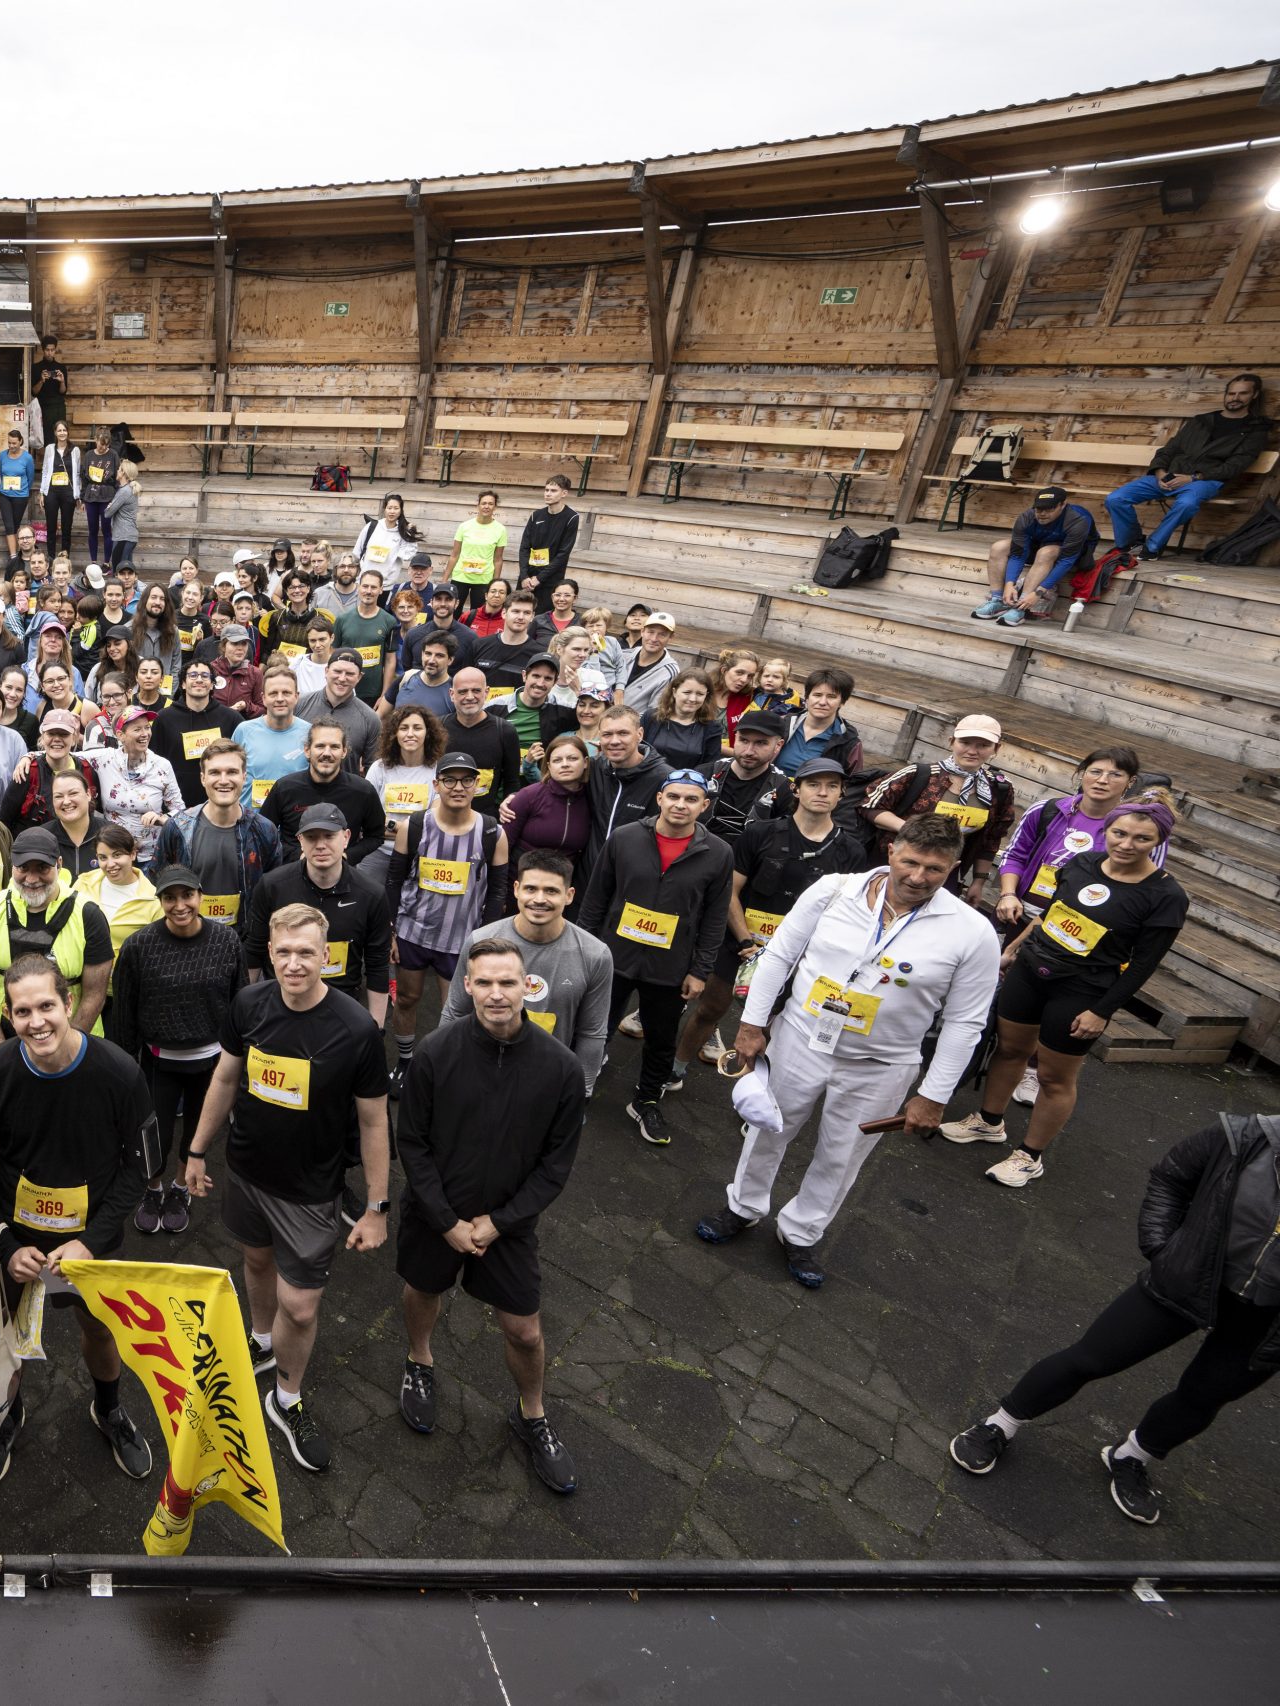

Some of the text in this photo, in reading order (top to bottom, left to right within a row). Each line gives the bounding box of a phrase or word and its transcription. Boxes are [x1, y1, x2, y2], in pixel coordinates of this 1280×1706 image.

[195, 737, 210, 748] 498
[397, 792, 415, 803] 472
[433, 869, 453, 882] 393
[208, 905, 225, 916] 185
[635, 918, 658, 934] 440
[1059, 918, 1082, 937] 460
[261, 1068, 286, 1088] 497
[35, 1199, 64, 1217] 369
[152, 1370, 188, 1438] K
